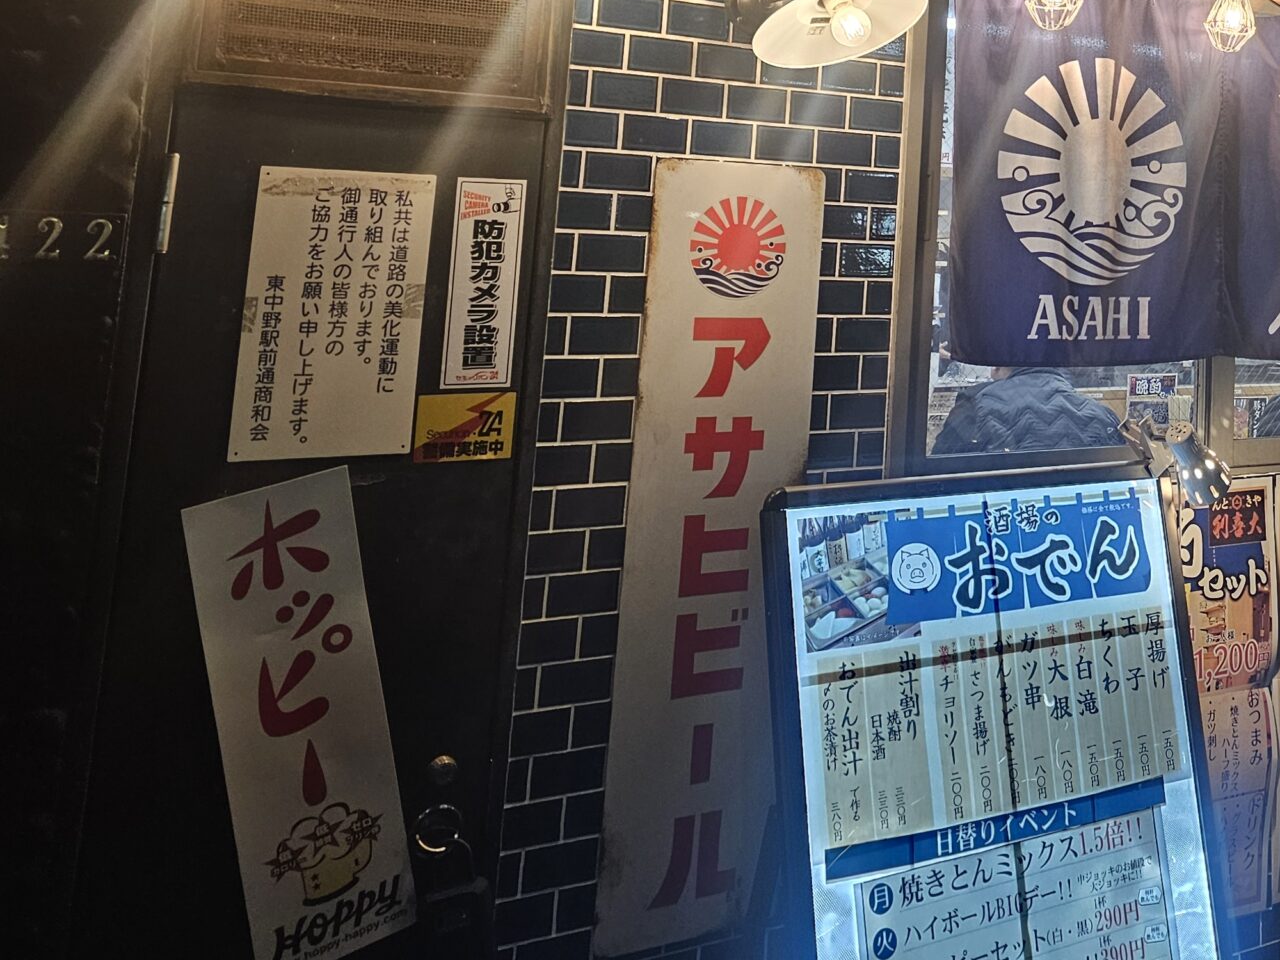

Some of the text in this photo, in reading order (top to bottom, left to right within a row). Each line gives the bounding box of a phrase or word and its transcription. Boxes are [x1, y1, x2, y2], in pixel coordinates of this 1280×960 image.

[325, 187, 361, 357] 御通行人の皆様方の
[352, 189, 388, 366] 取り組んでおります。
[376, 189, 414, 394] 私共は道路の美化運動に
[461, 219, 507, 371] 防犯カメラ設置
[289, 187, 332, 445] ご協力をお願い申し上げます。
[1027, 294, 1151, 341] ASAHI
[249, 274, 287, 442] 東中野駅前通商和会
[985, 503, 1060, 535] 酒場の
[945, 515, 1139, 616] おでん
[1198, 558, 1268, 600] セット
[226, 498, 354, 807] ホッピー
[644, 315, 772, 912] アサヒビール
[1144, 611, 1170, 689] 厚揚げ
[1020, 631, 1043, 711] ガツ串
[1047, 659, 1073, 721] 大根
[1076, 656, 1100, 716] 白滝
[1099, 619, 1120, 695] ちくわ
[1120, 615, 1146, 692] 玉子
[886, 710, 902, 742] 焼酎
[898, 650, 921, 741] 出汁割り
[940, 675, 957, 765] チョリソー
[969, 669, 990, 756] さつま揚げ
[1247, 689, 1263, 766] おつまみ
[838, 661, 864, 822] おでん出汁 で作る
[870, 713, 886, 762] 日本酒
[934, 801, 1077, 858] 日替りイベント
[1243, 792, 1264, 871] ドリンク
[874, 886, 889, 910] 月
